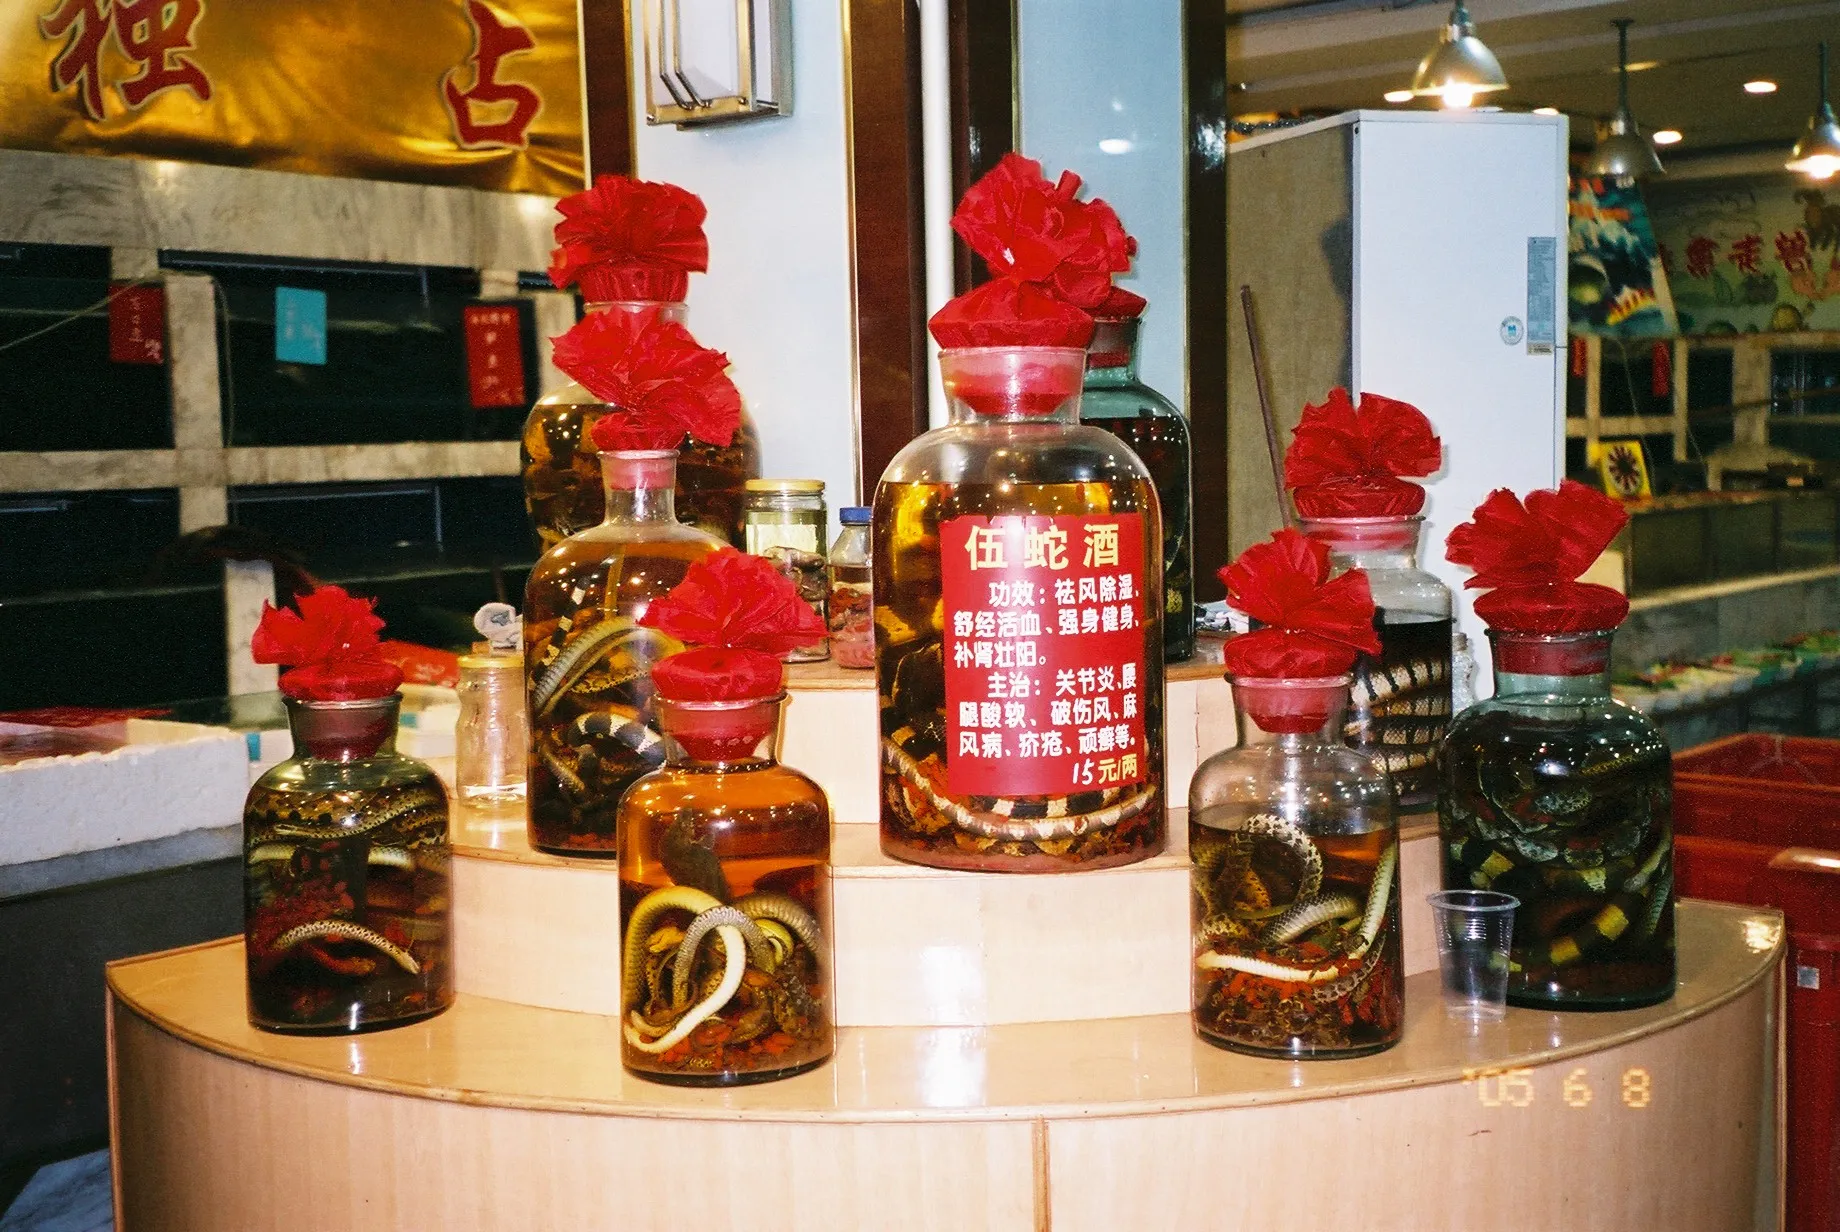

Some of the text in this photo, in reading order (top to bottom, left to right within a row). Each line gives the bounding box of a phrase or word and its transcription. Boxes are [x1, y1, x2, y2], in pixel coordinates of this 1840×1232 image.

[965, 523, 1120, 570] 伍蛇酒
[953, 641, 1047, 668] 补肾壮阳。
